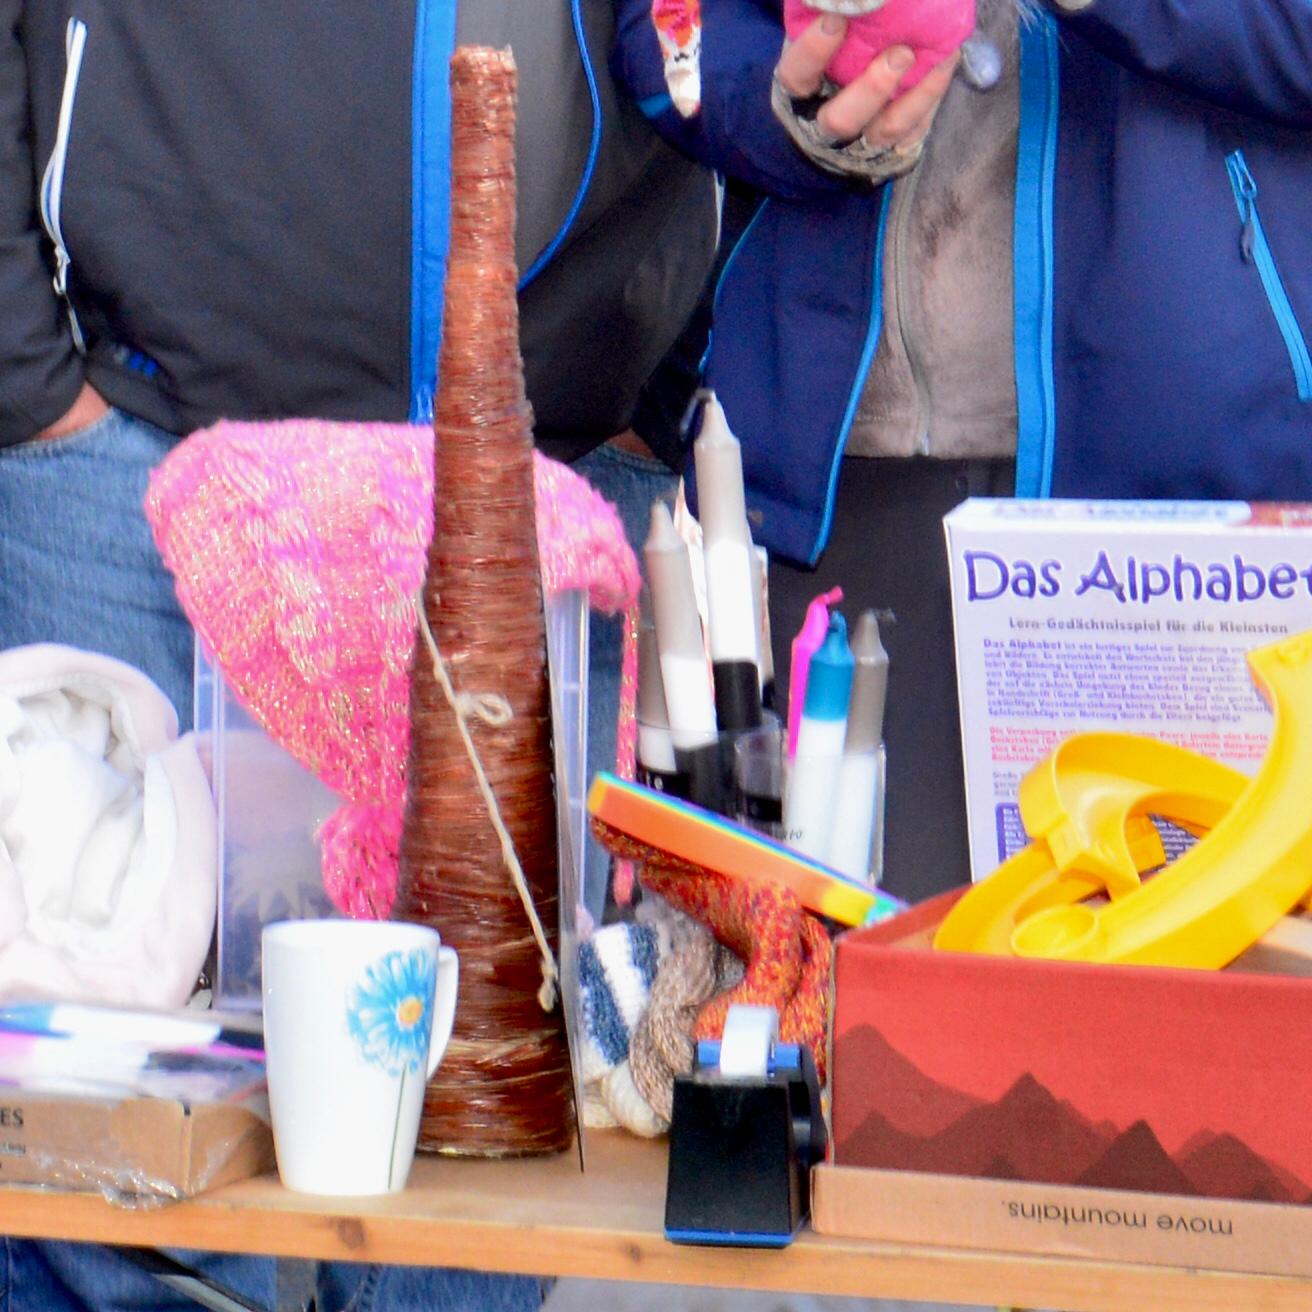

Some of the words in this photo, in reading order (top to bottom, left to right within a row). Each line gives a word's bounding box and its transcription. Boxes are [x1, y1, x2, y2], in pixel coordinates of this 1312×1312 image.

[964, 549, 1062, 603] Das
[1167, 619, 1187, 632] für
[1193, 621, 1214, 633] die
[1220, 621, 1288, 634] Kleinsten
[1001, 1200, 1147, 1228] mountains.
[1156, 1214, 1233, 1236] move
